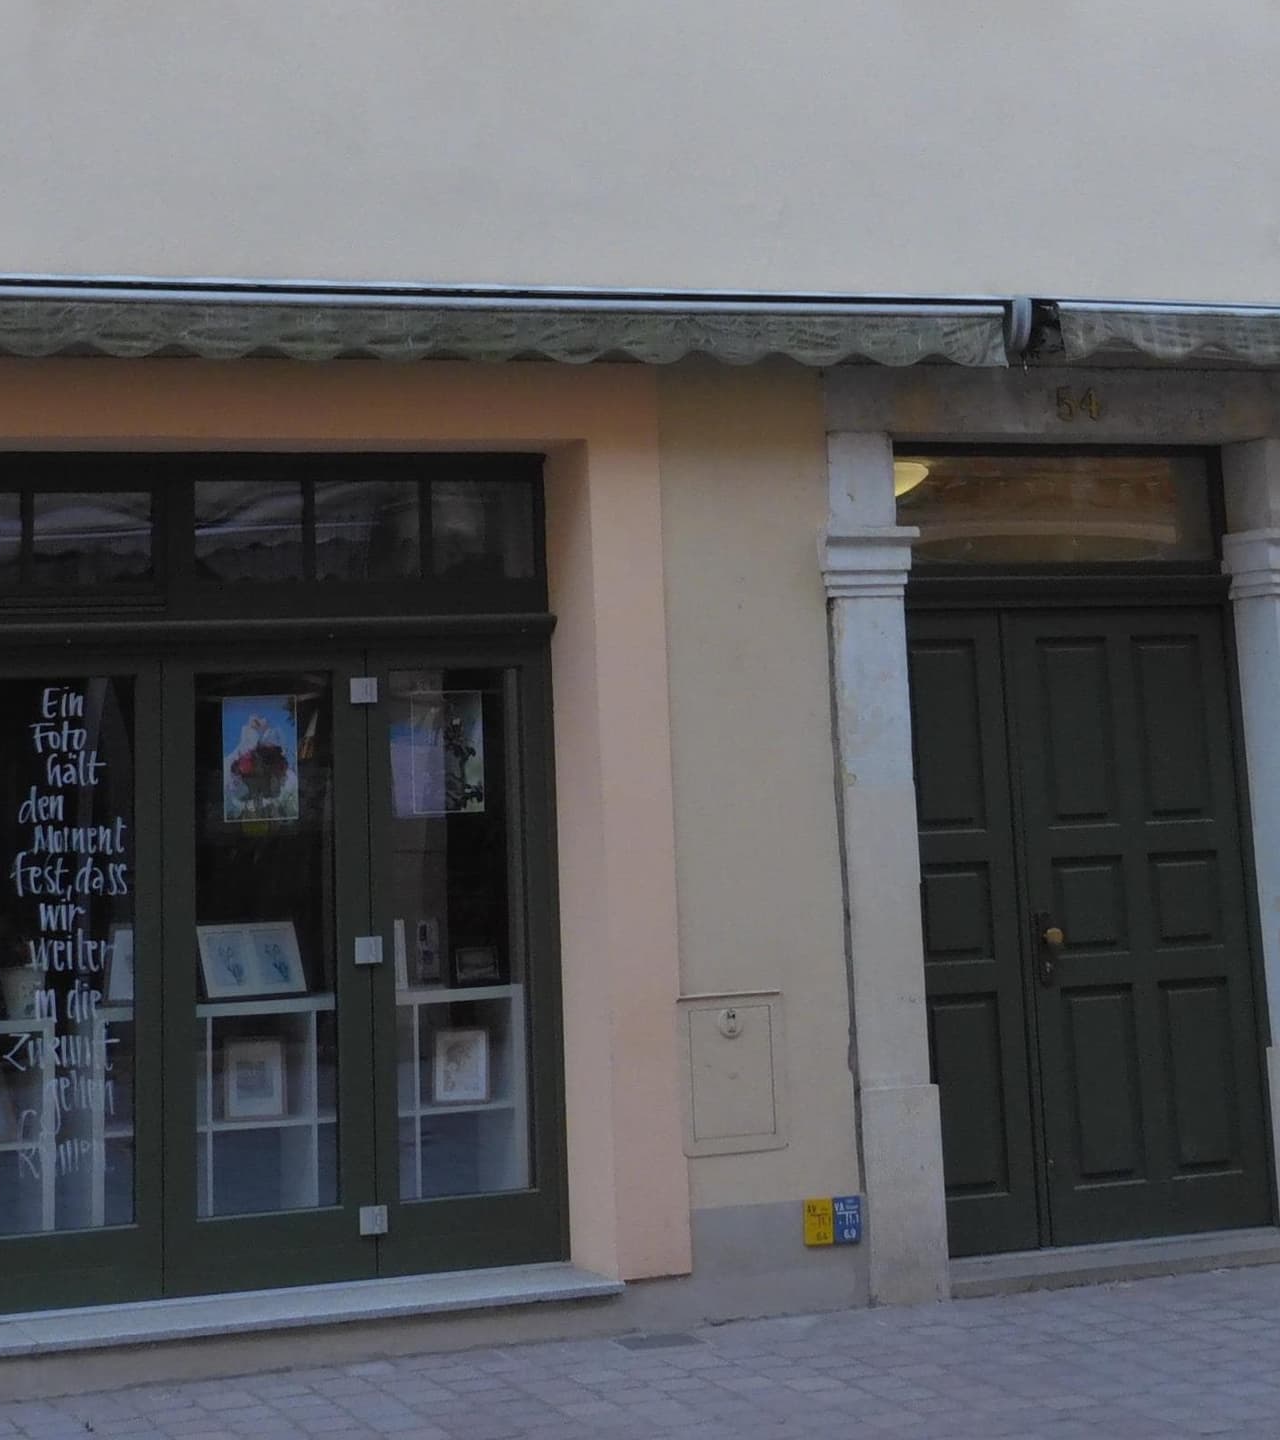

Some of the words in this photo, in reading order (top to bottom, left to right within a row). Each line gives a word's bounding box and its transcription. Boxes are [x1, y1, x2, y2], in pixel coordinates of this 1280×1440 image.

[1055, 386, 1101, 422] 54
[41, 686, 84, 719] Ein
[29, 720, 87, 753] Foto
[47, 750, 107, 788] hält
[18, 785, 65, 824] den
[32, 816, 127, 855] Moment
[39, 898, 86, 932] wir
[29, 927, 116, 972] weiter
